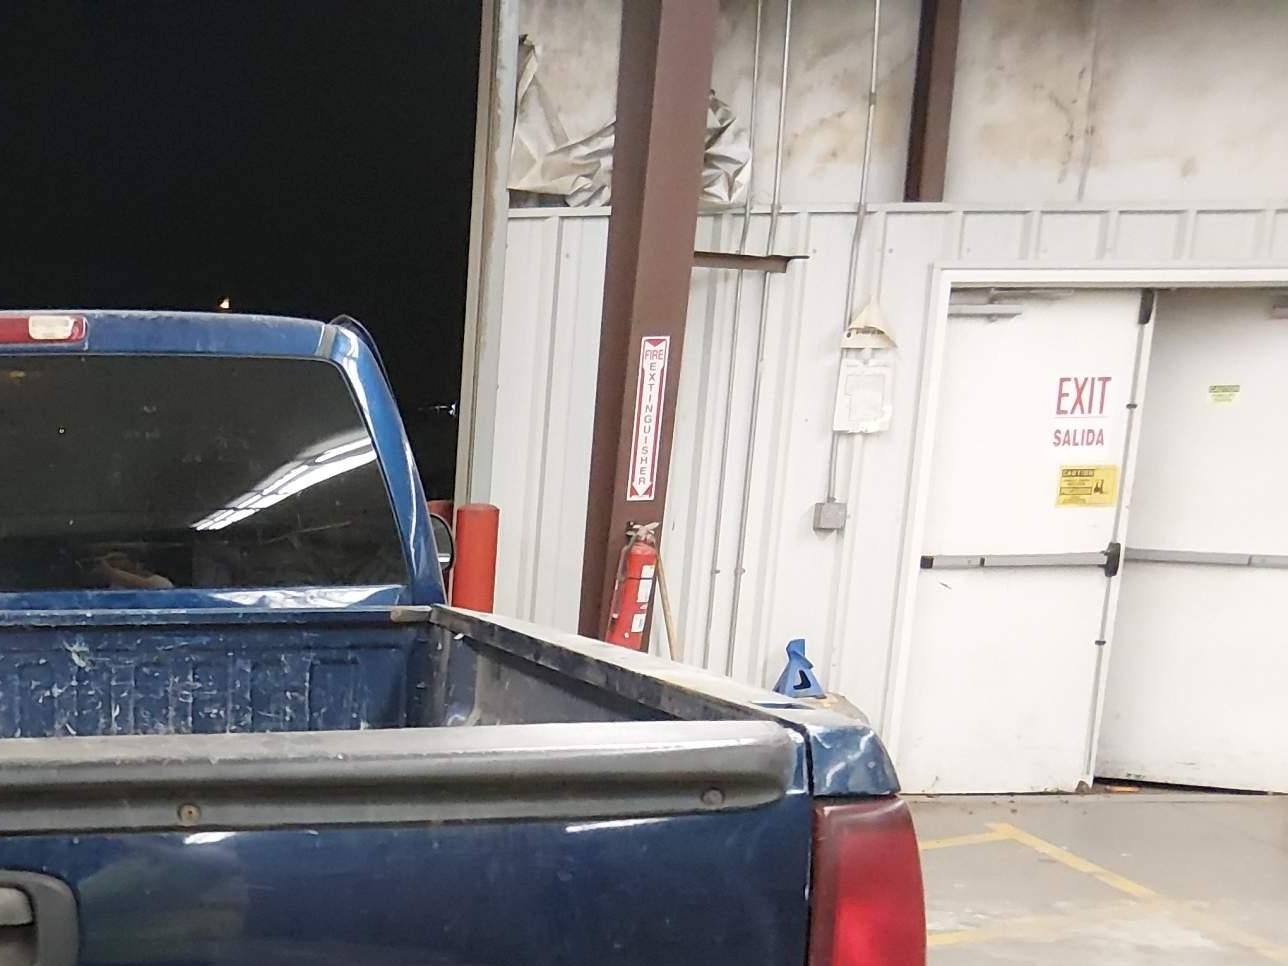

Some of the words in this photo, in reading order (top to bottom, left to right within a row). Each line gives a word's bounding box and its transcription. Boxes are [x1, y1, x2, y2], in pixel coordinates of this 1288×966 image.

[644, 350, 664, 361] FIRE
[1055, 376, 1112, 415] EXIT
[638, 362, 657, 485] EXTINGUISHER
[1052, 428, 1105, 447] SALIDA
